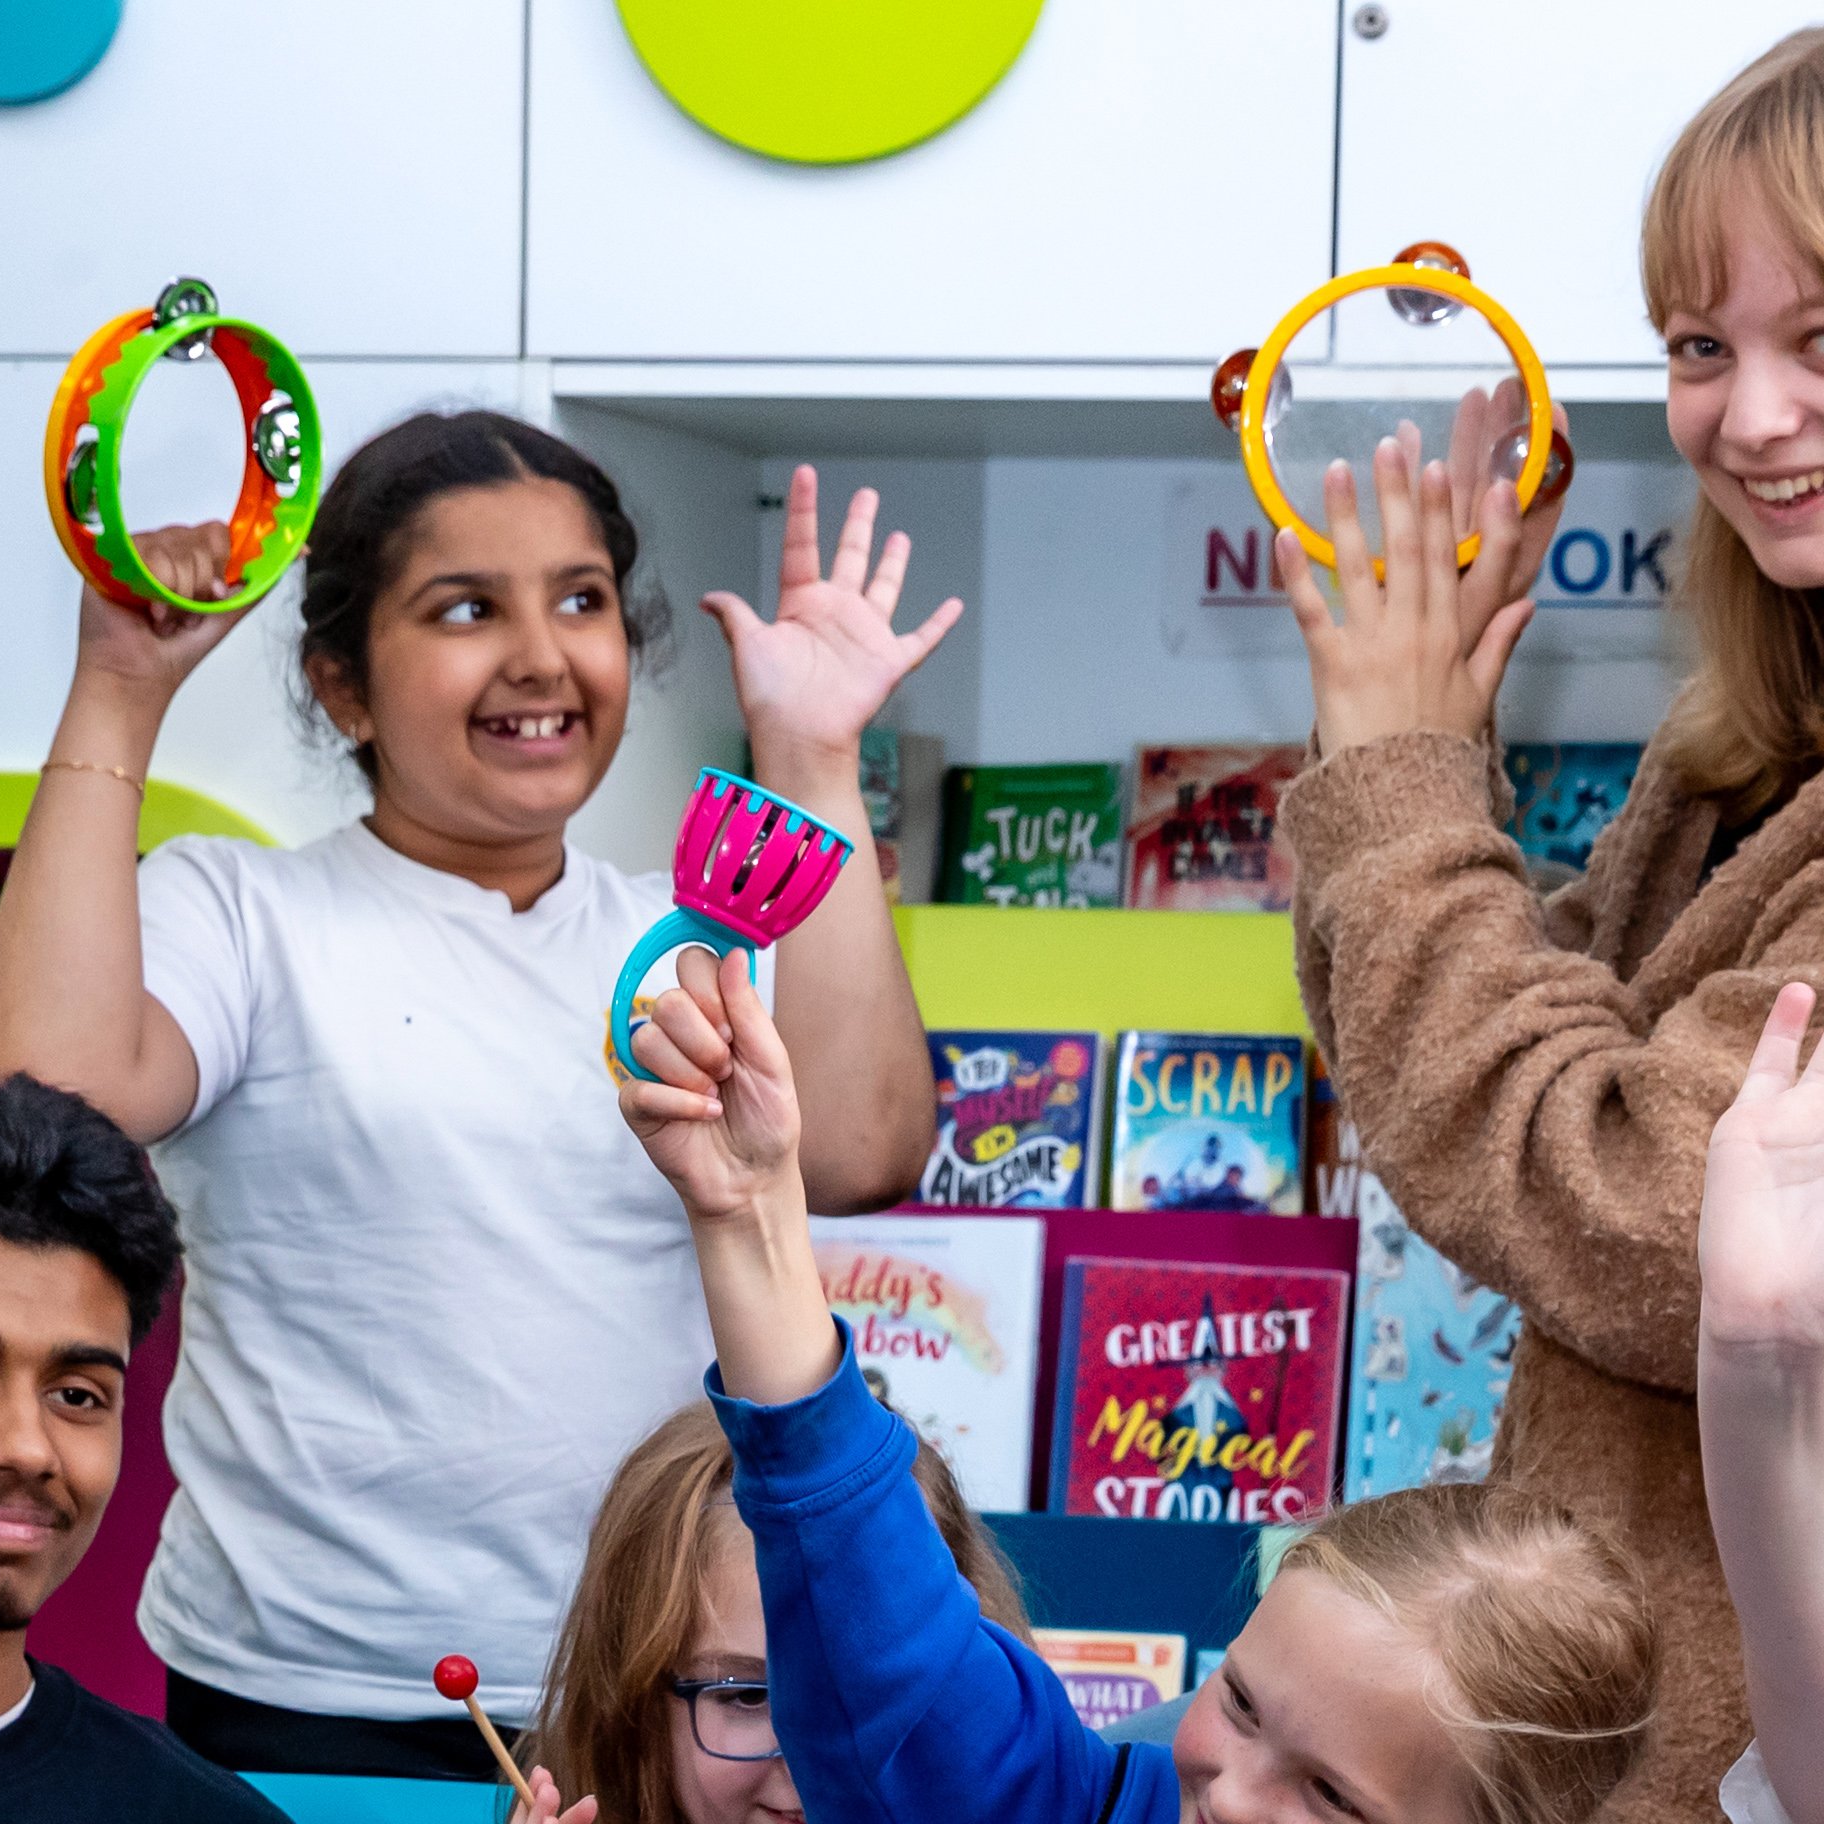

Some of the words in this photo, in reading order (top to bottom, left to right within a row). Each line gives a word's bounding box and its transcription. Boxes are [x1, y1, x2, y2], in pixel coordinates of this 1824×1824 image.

[984, 804, 1100, 864] TUCK
[1125, 1050, 1294, 1118] SCRAP
[928, 1144, 1060, 1206] AWESOME
[1104, 1309, 1316, 1368] GREATEST
[1087, 1395, 1316, 1482] Magical
[1065, 1680, 1146, 1711] WHAT
